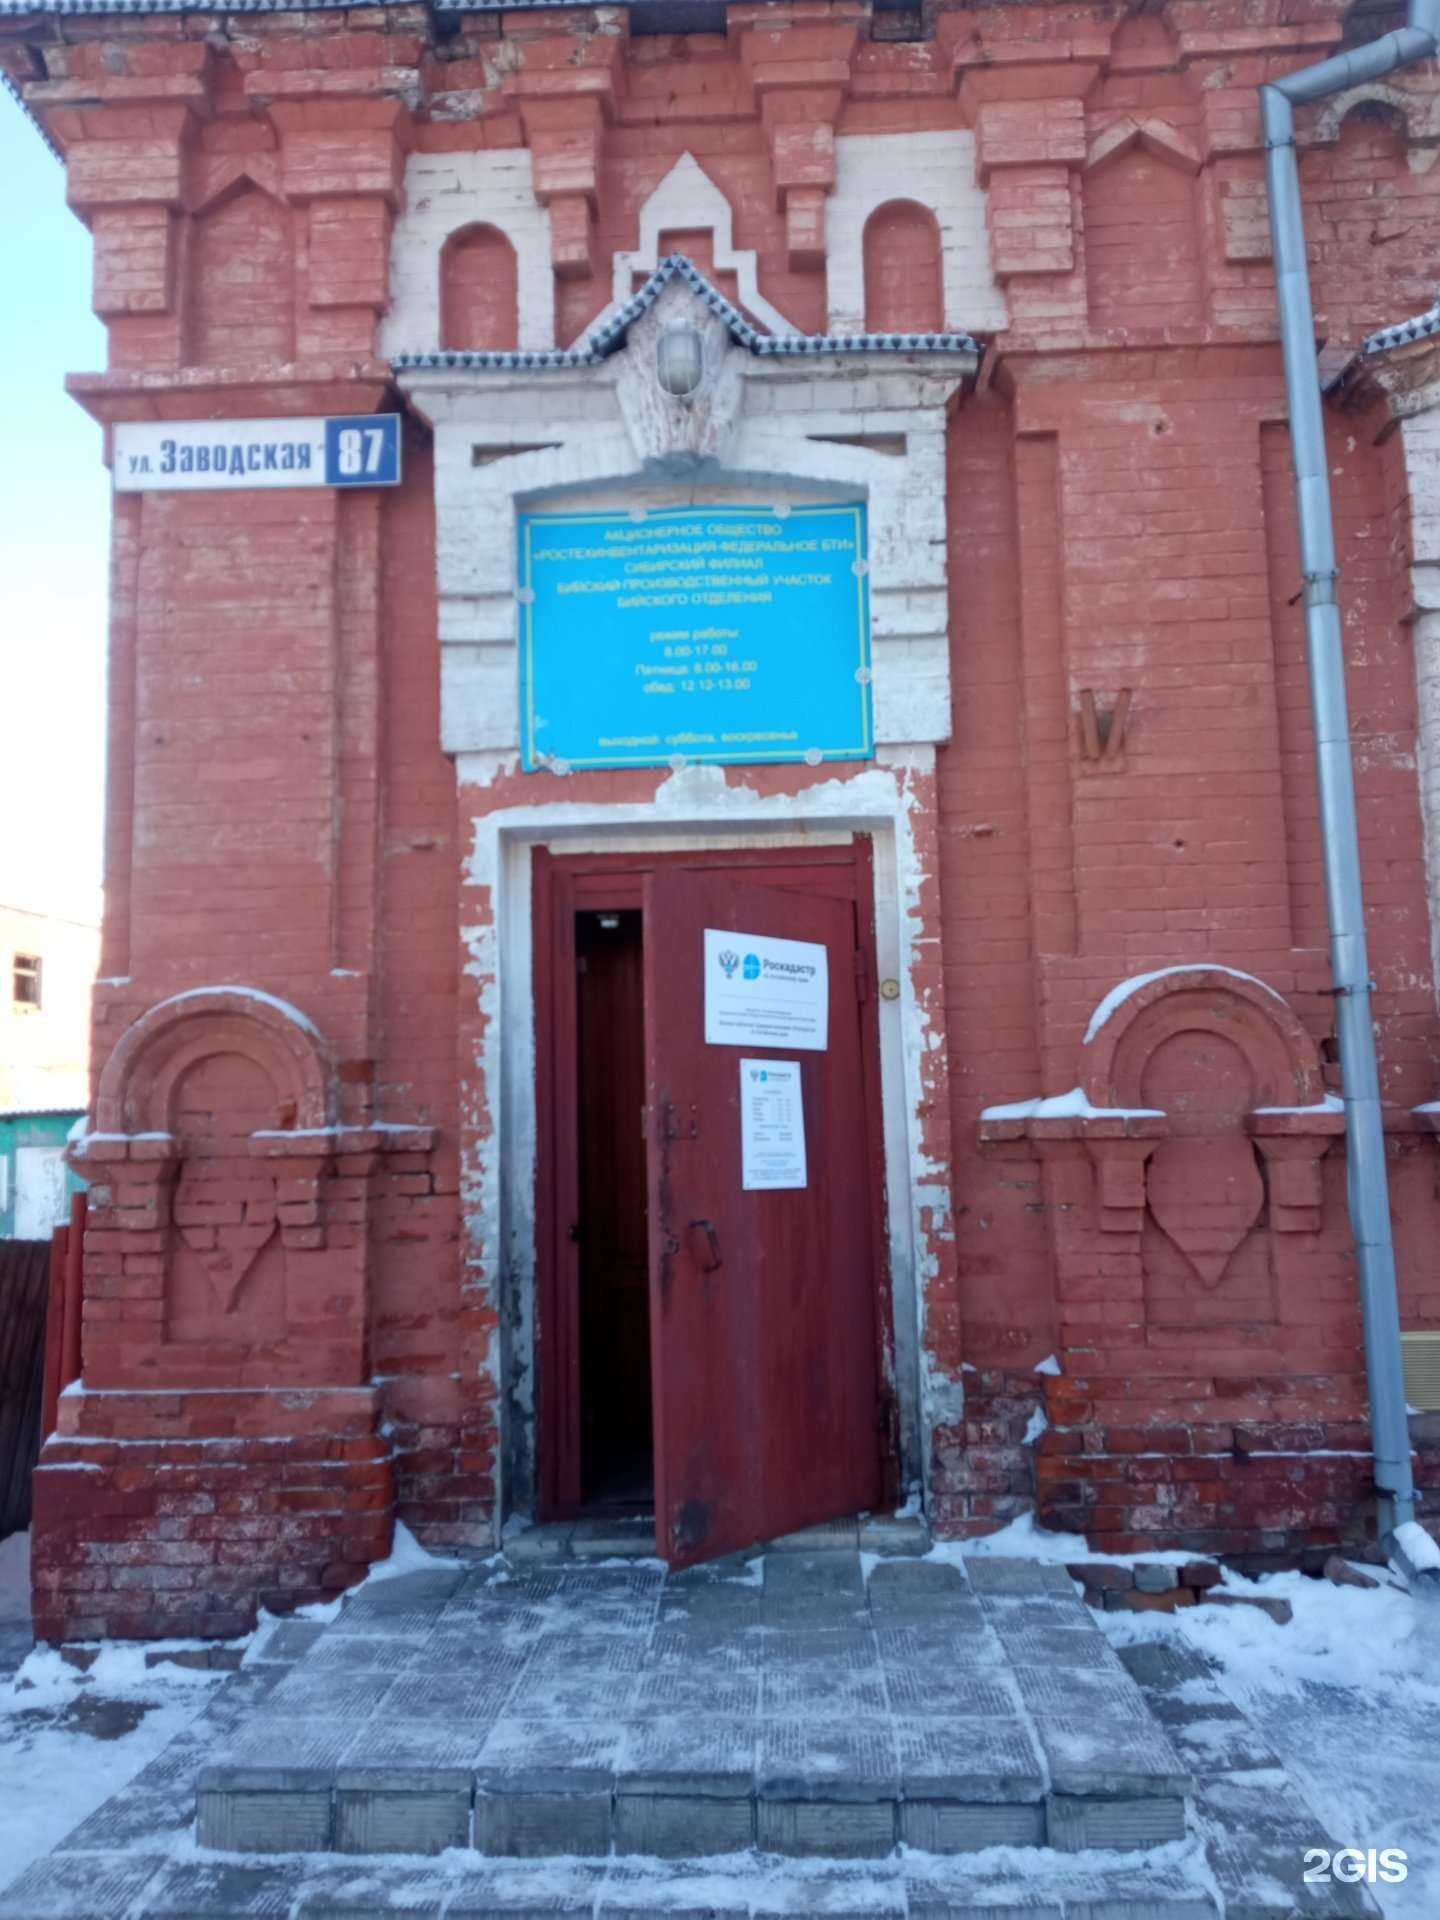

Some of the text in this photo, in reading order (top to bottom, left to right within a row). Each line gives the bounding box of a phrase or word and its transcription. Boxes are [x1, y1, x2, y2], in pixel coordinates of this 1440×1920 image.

[129, 440, 310, 475] ул. Заводская
[338, 429, 384, 475] 87
[605, 524, 782, 541] АКЦИОНЕРНОЕ ОБЩЕСТВО
[625, 558, 763, 573] СИБИРСКИЙ ФИЛИАЛ
[557, 573, 831, 595] БИЙСКИЙ ПРОИЗВОДСТВЕННЫЙ УЧАСТОК
[618, 592, 773, 609] БИЙСКОГО ОТДЕЛЕНИЯ
[763, 959, 816, 977] Роскадастр
